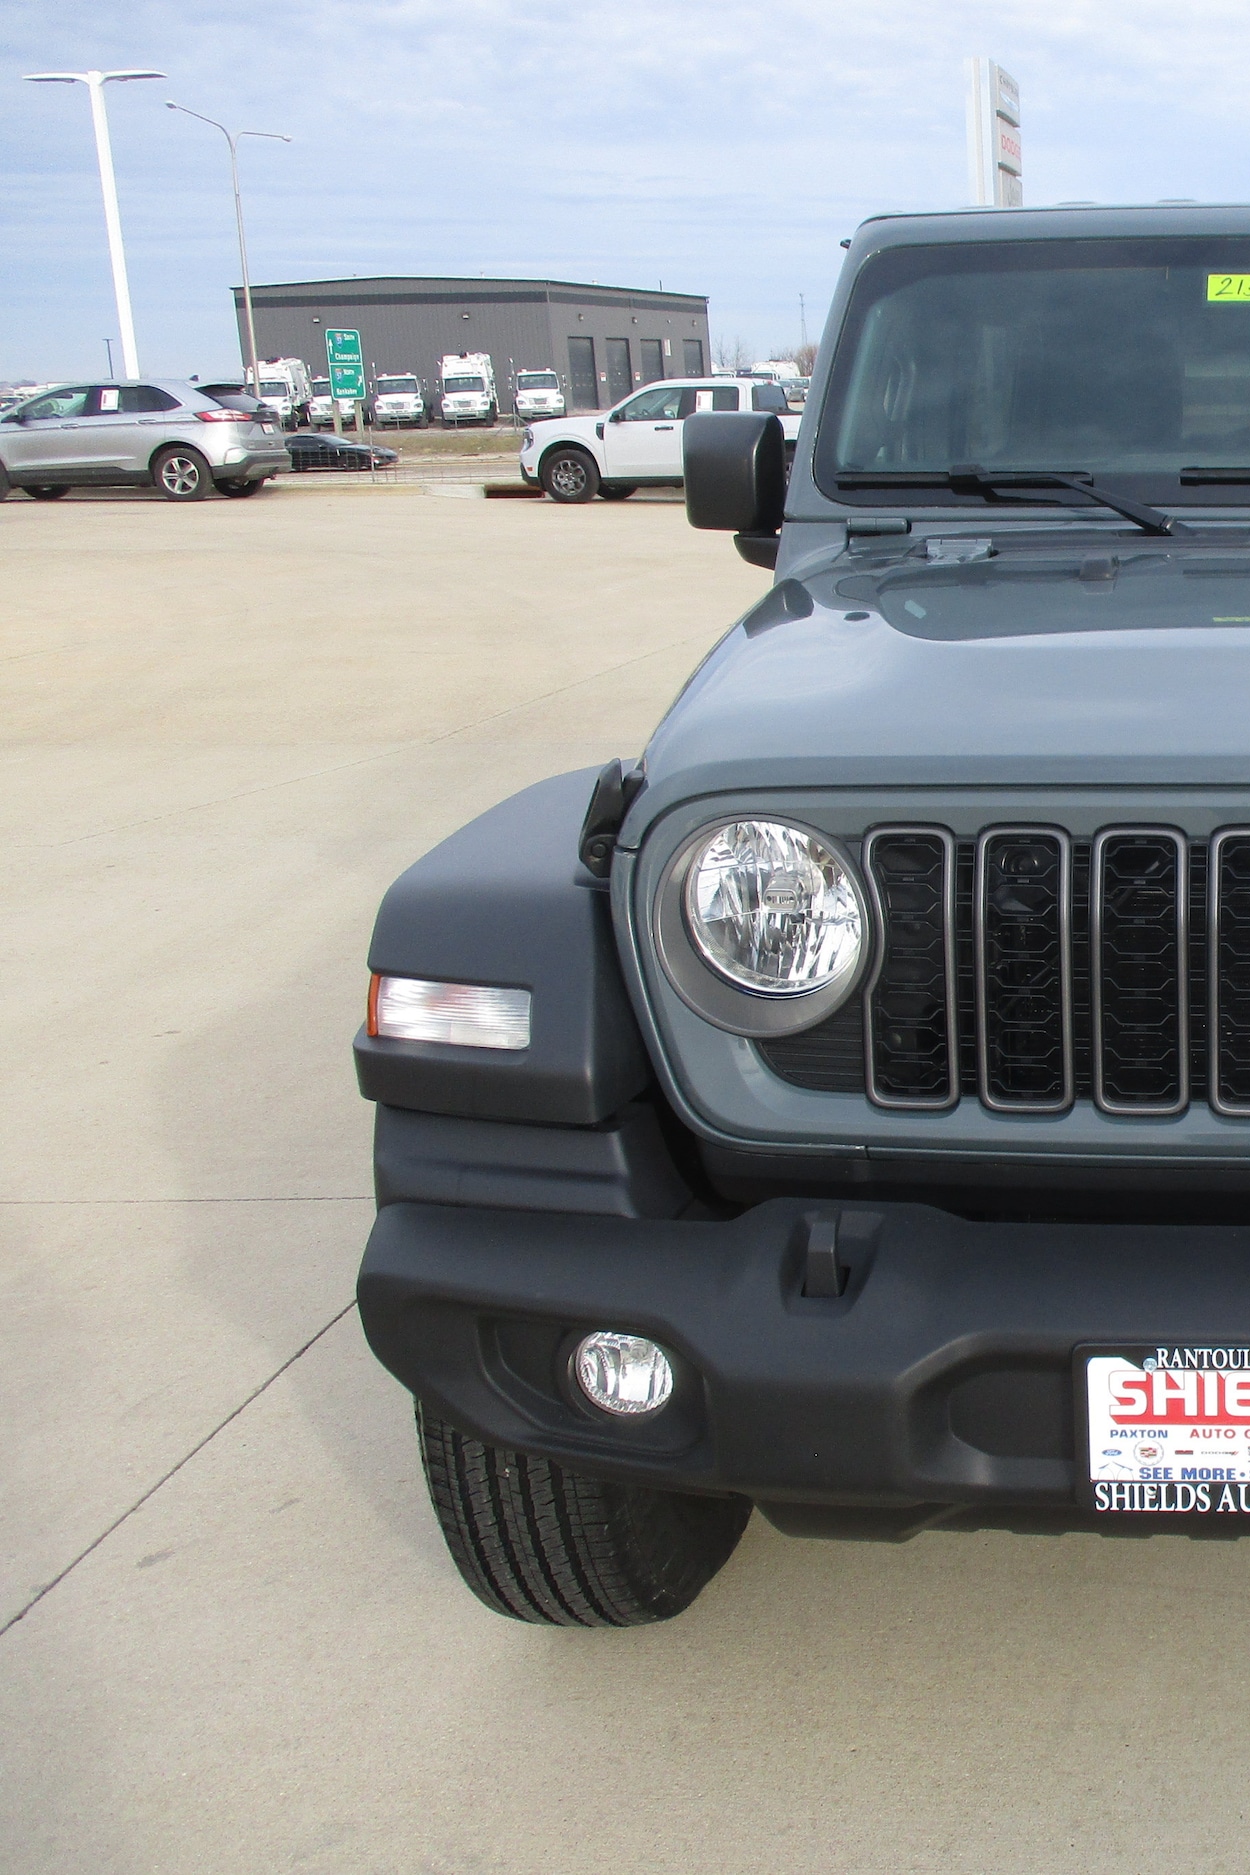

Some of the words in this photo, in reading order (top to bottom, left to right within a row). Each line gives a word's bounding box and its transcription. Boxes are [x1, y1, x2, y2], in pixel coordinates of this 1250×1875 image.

[335, 353, 359, 361] Champaign
[1110, 1429, 1168, 1439] PAXTON
[1190, 1428, 1236, 1439] AUTO
[1139, 1467, 1173, 1480] SEE
[1181, 1467, 1236, 1480] MORE
[1094, 1482, 1211, 1512] SHIELDS
